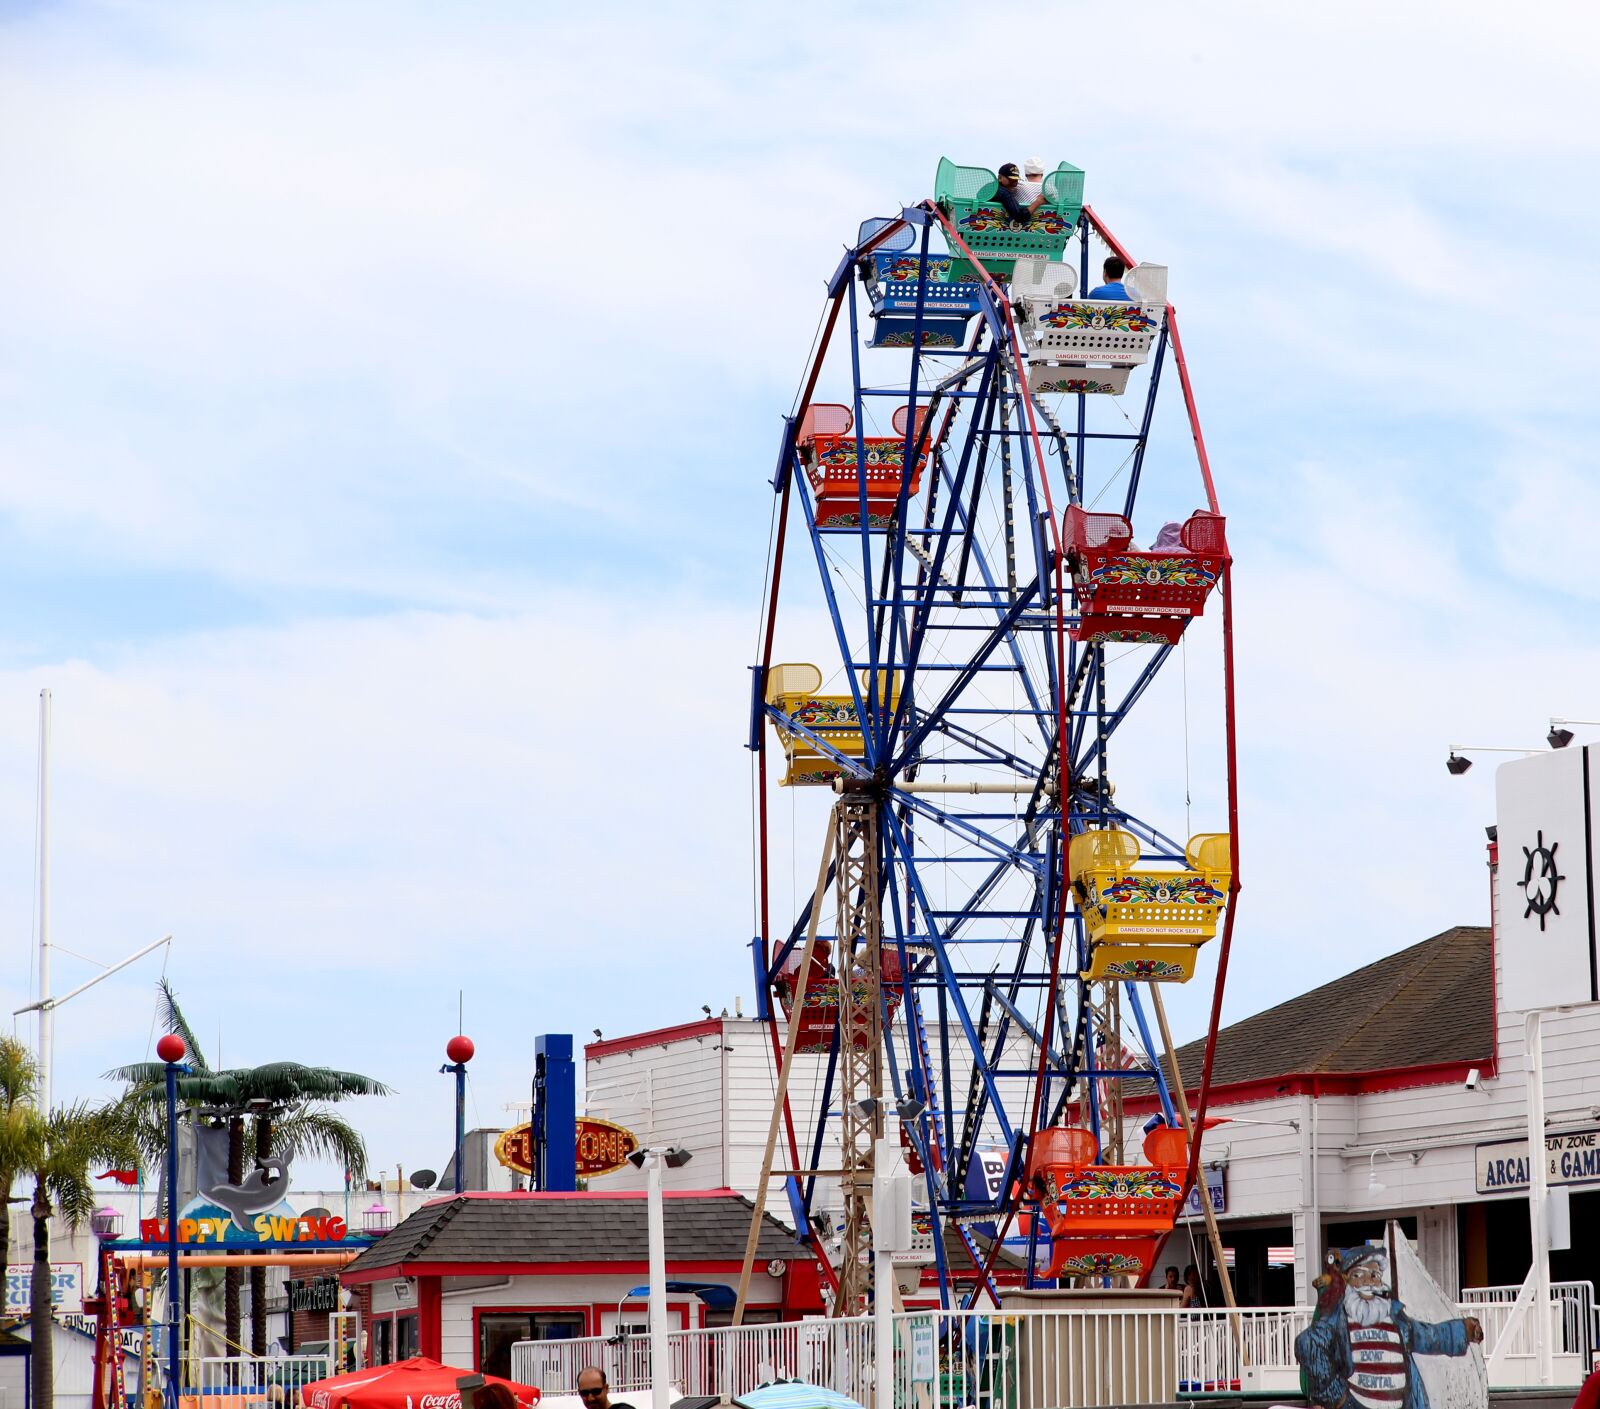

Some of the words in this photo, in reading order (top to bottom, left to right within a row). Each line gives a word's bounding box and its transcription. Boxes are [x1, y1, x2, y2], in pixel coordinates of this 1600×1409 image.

[839, 711, 846, 719] 3
[1159, 889, 1167, 897] 9
[1566, 1134, 1597, 1149] ZONE
[505, 1133, 532, 1164] FU
[1486, 1156, 1530, 1187] ARCA
[1550, 1159, 1557, 1175] &
[1116, 1184, 1127, 1193] 10
[140, 1218, 232, 1243] HAPPY
[254, 1215, 347, 1242] SWING
[1360, 1350, 1385, 1362] BOAT
